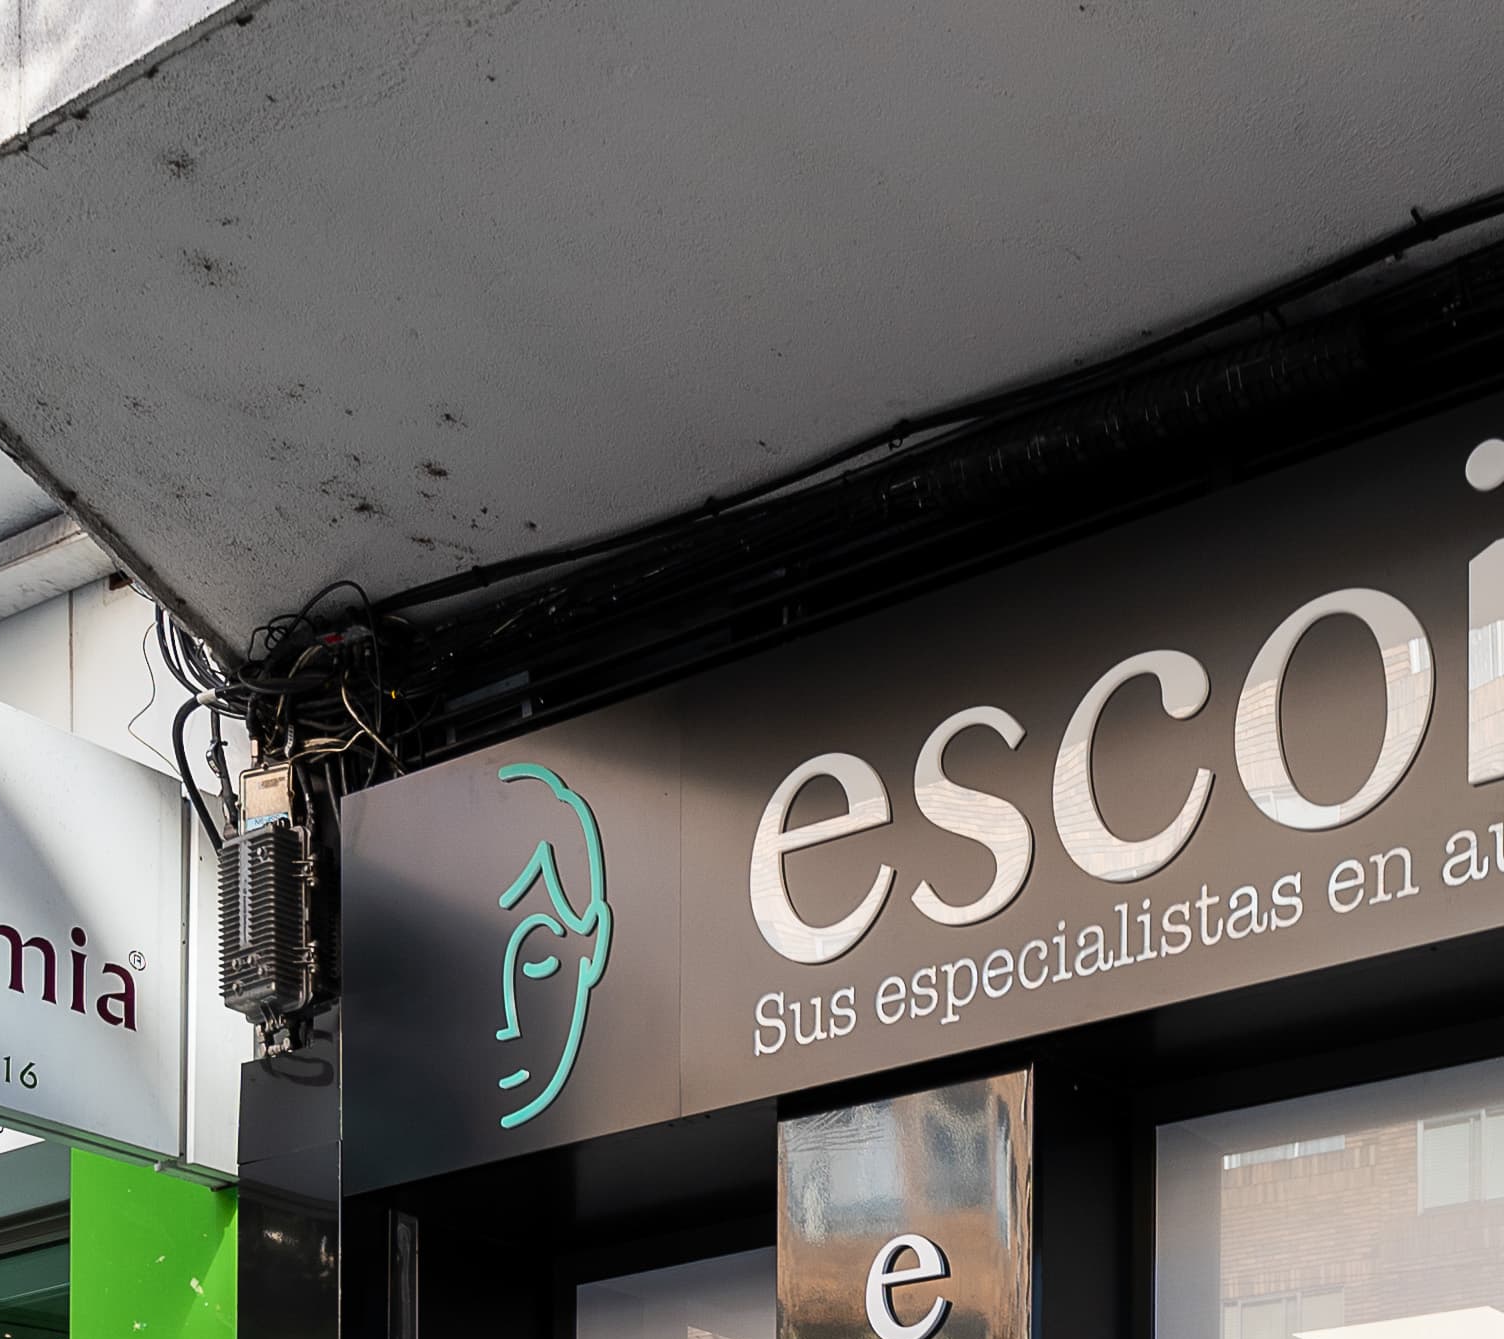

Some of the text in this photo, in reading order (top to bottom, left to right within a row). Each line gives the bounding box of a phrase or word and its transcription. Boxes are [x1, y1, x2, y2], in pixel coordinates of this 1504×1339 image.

[753, 985, 857, 1057] Sus
[873, 868, 1304, 1026] especialistas
[1326, 845, 1420, 914] en
